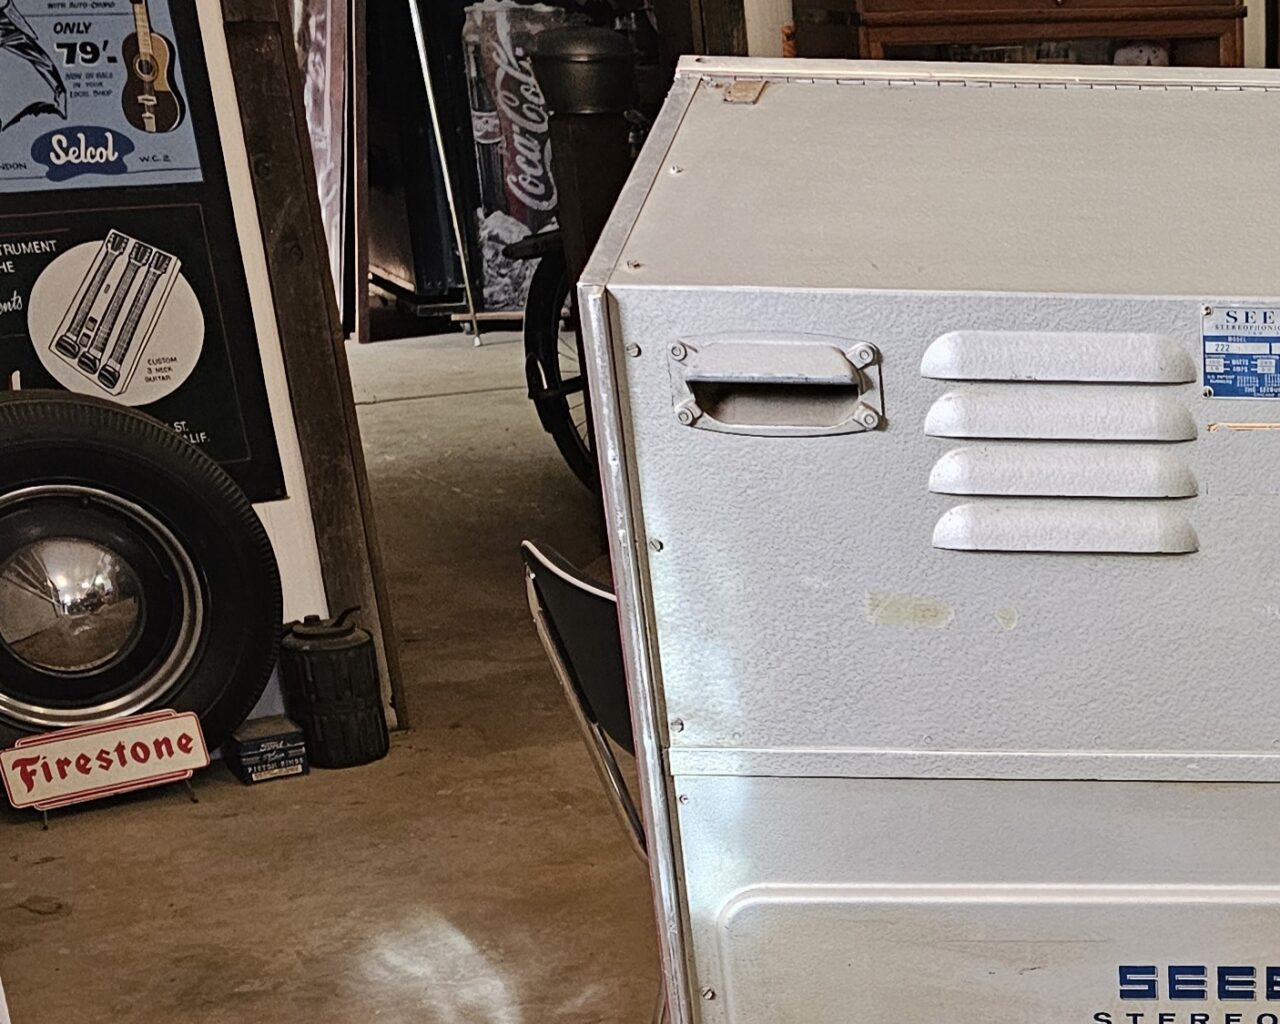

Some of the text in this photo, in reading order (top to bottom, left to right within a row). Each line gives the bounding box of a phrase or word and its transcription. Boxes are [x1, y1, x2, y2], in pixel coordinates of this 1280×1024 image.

[53, 22, 92, 35] ONLY
[50, 132, 118, 165] Selcol
[1215, 343, 1230, 352] 222
[147, 356, 177, 366] CUSTOM
[12, 732, 194, 793] Firestone
[248, 763, 277, 773] PISTON
